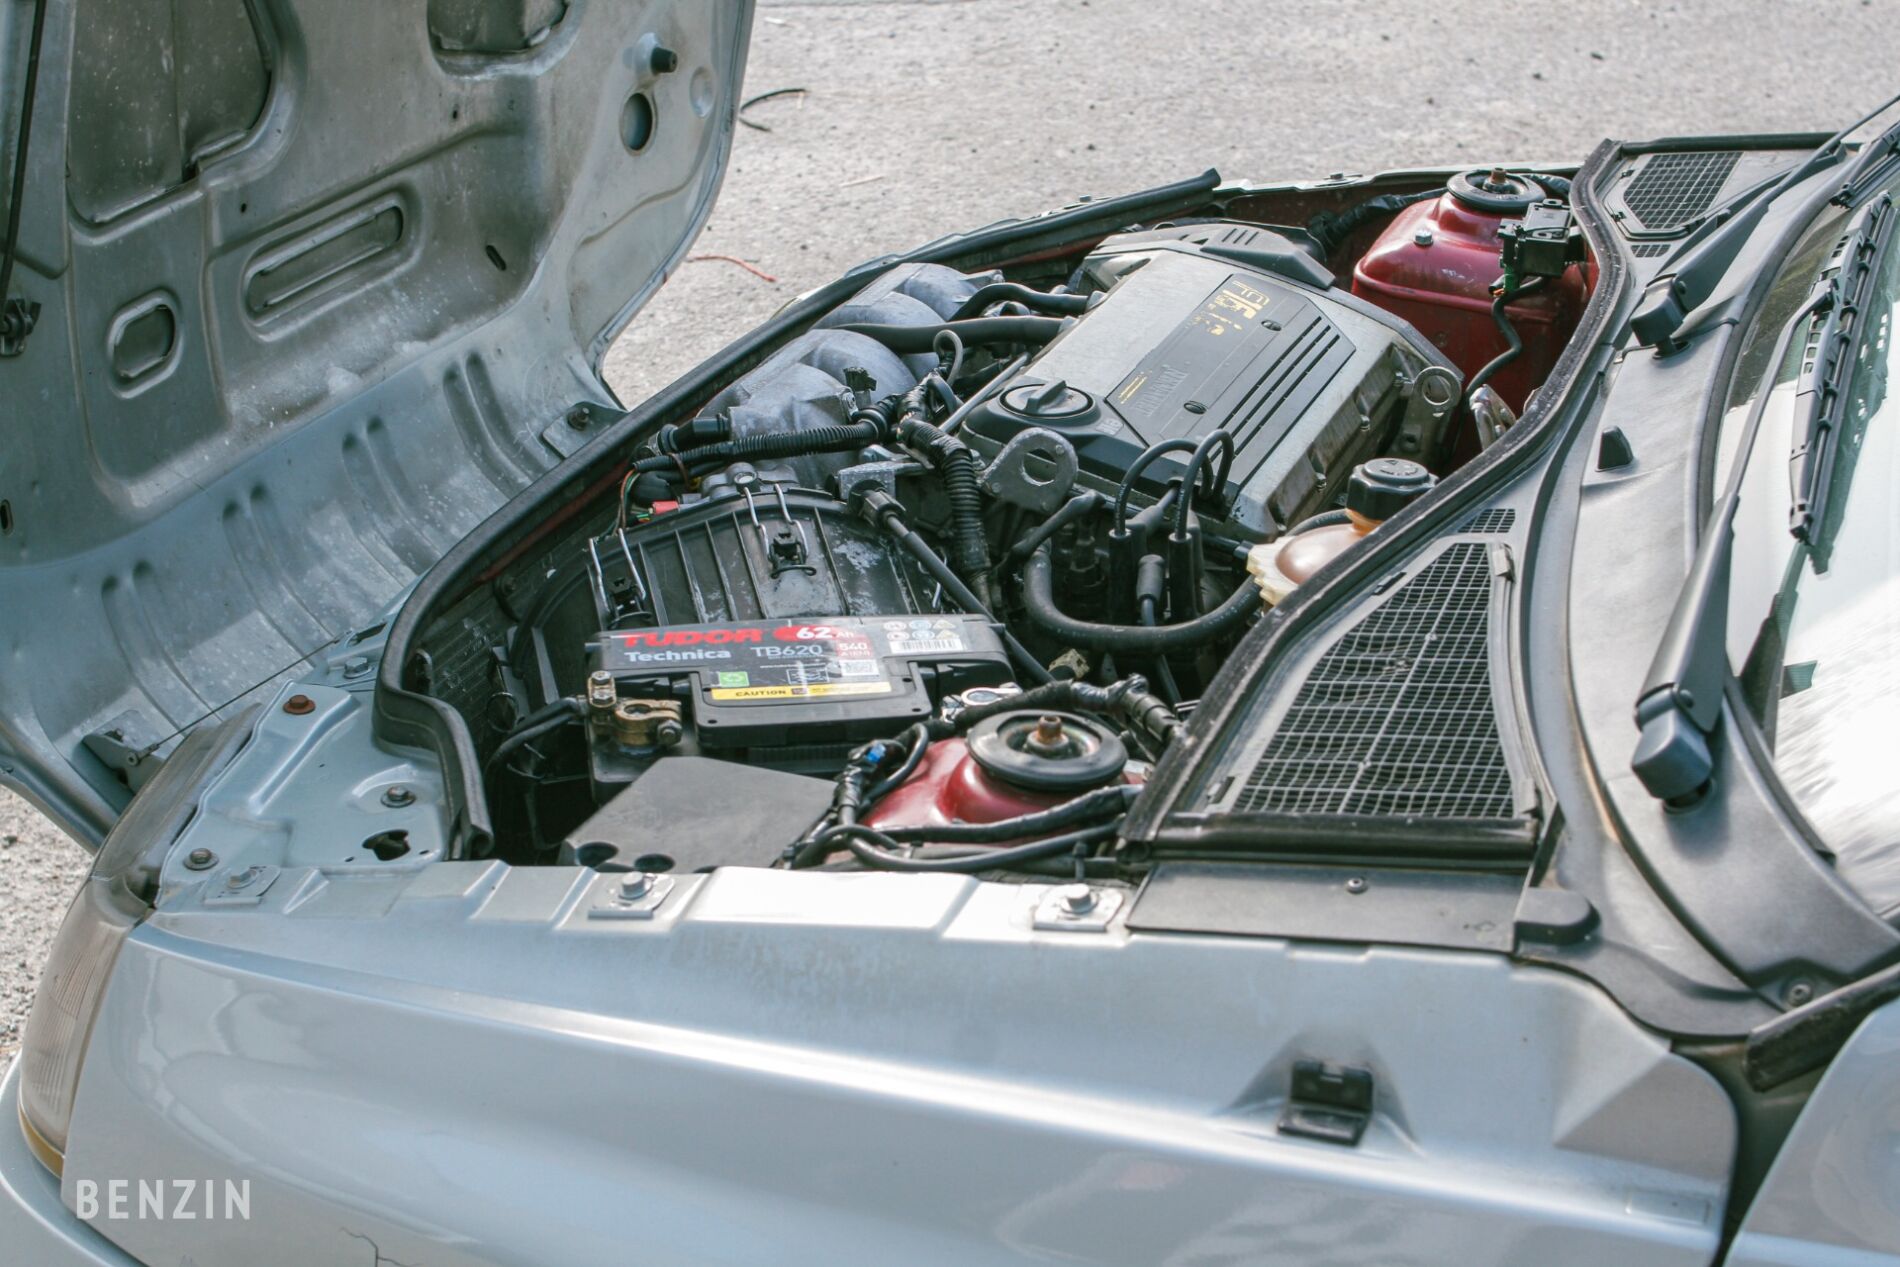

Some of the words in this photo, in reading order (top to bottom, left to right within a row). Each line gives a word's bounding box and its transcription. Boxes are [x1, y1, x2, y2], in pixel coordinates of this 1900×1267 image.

[616, 627, 763, 647] TUDOR
[796, 626, 833, 639] 62
[750, 644, 823, 657] TB620
[839, 642, 868, 651] 540
[624, 649, 732, 662] Technica
[735, 689, 787, 697] CAUTION
